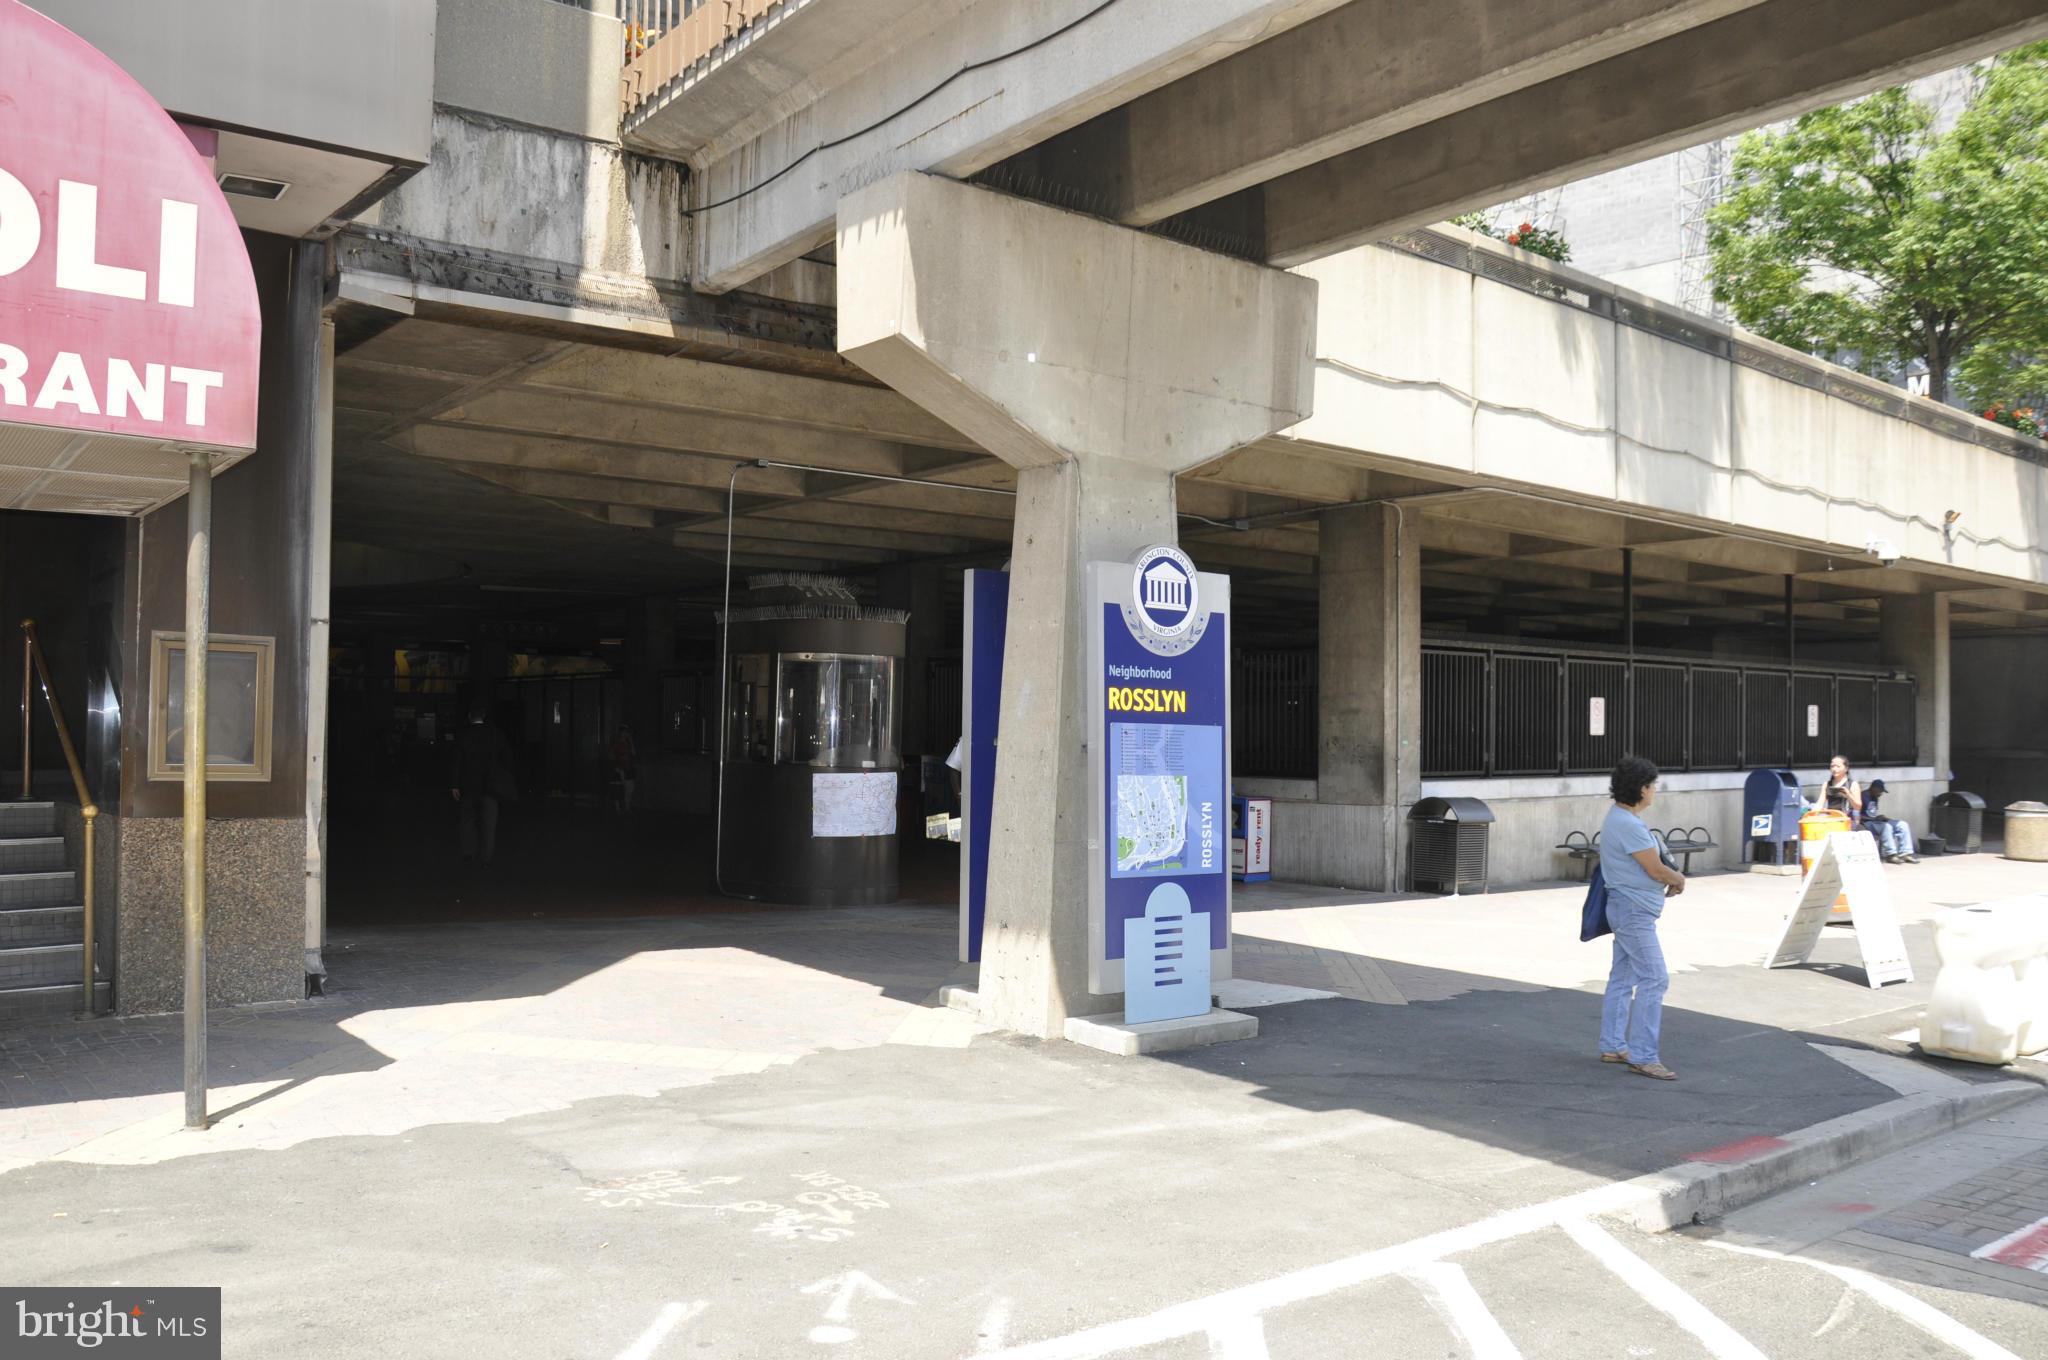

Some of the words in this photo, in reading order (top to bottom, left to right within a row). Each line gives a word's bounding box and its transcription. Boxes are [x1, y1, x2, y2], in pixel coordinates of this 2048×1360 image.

[1907, 374, 1930, 396] M
[1138, 548, 1170, 570] ARLINGTON
[1172, 551, 1194, 579] COUNTY
[1153, 624, 1182, 635] VIRGINIA
[1109, 664, 1172, 680] Neighborhood
[1108, 687, 1186, 713] ROSSLYN
[1202, 802, 1212, 868] ROSSLYN
